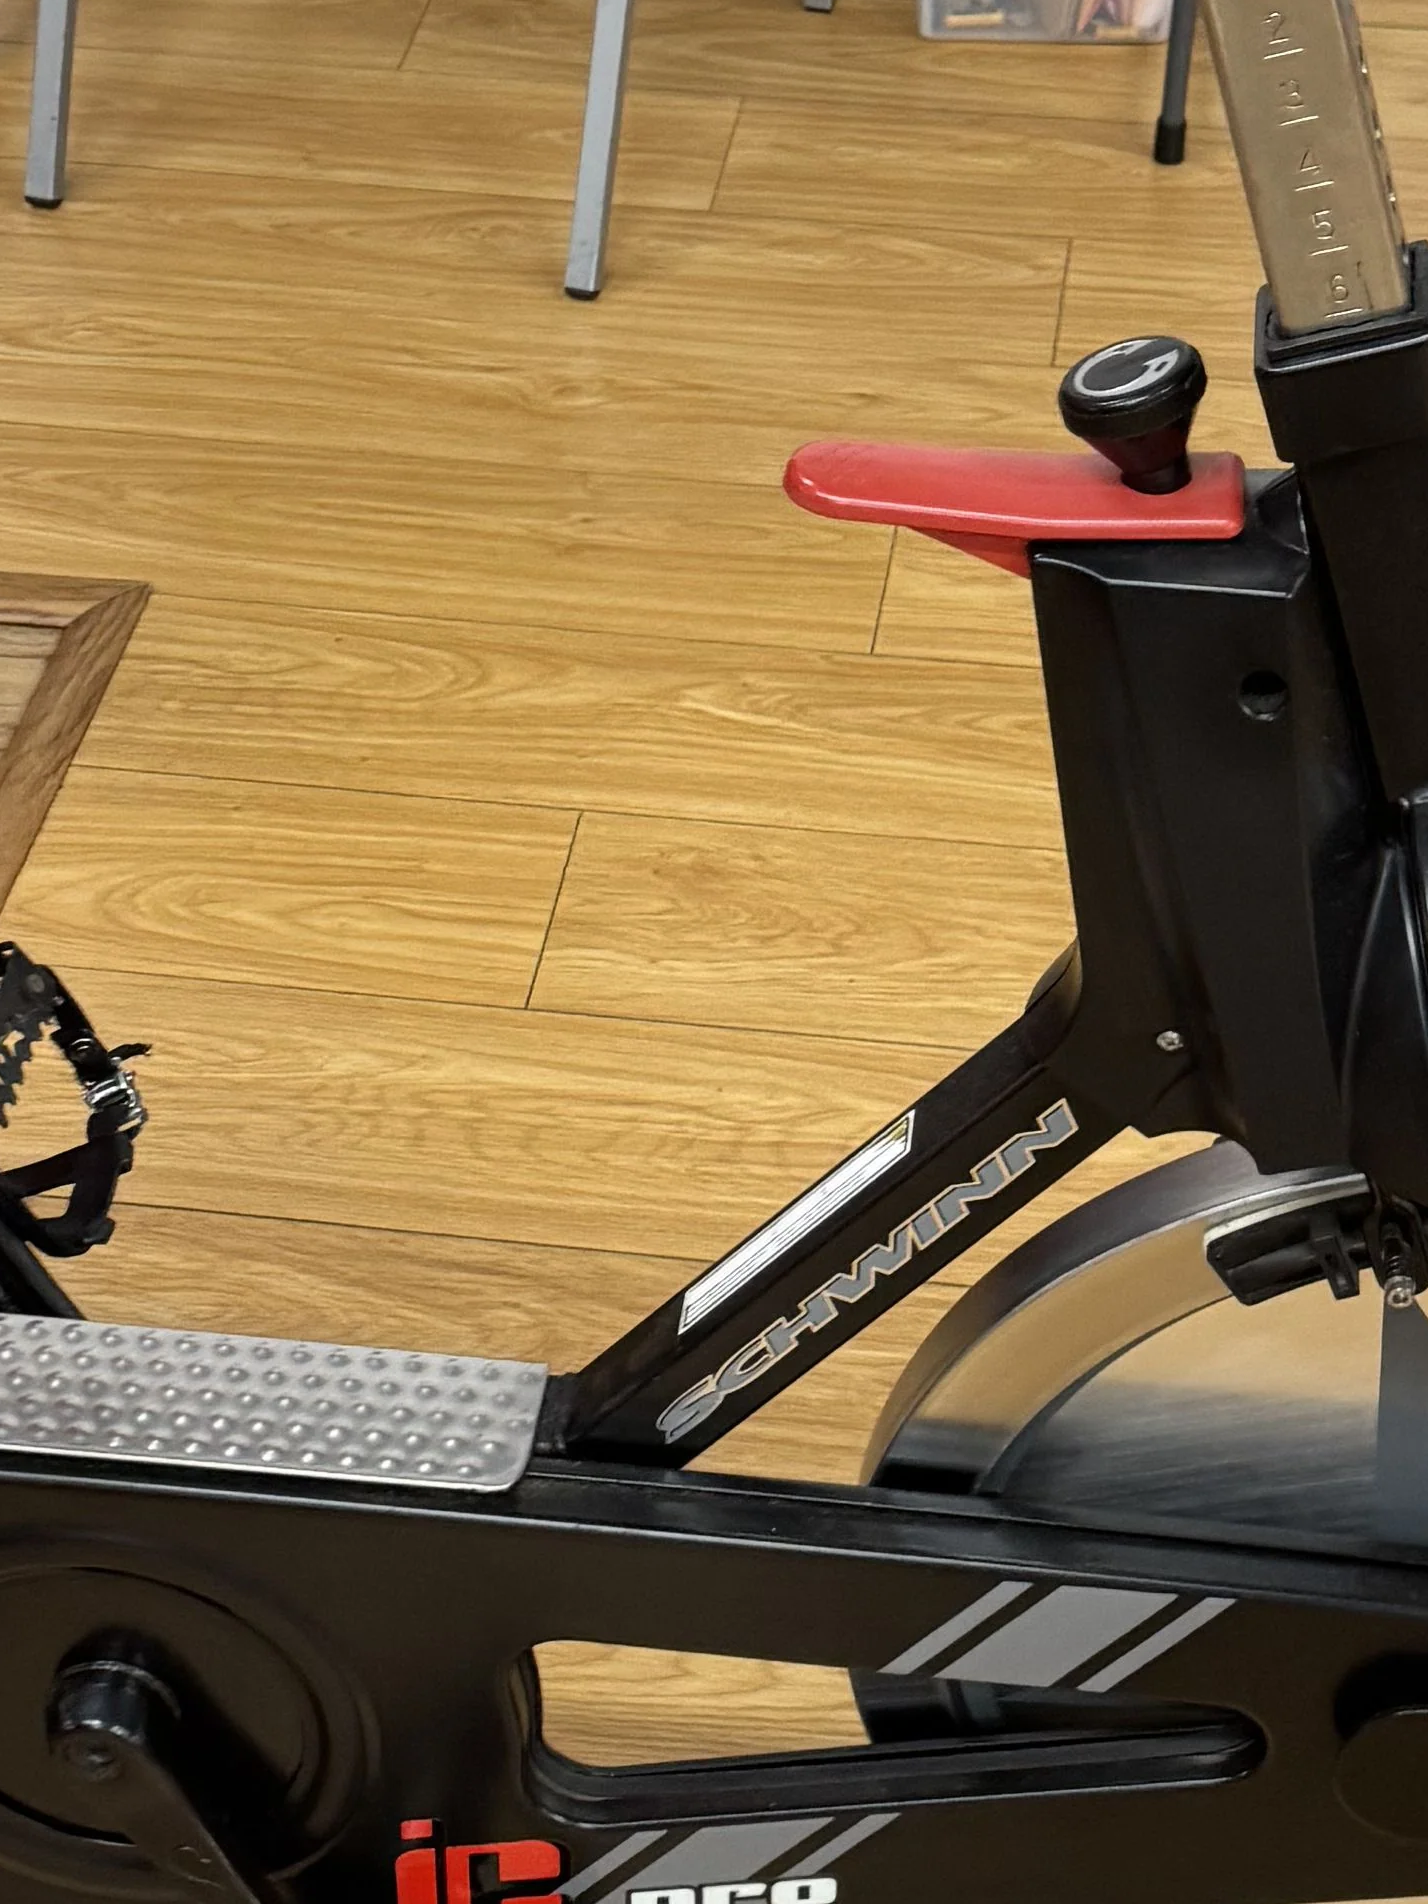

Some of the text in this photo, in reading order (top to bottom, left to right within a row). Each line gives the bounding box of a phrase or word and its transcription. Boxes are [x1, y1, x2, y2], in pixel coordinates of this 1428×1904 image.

[1311, 209, 1336, 241] 5
[1329, 273, 1350, 303] 6
[655, 1097, 1079, 1445] SCHWINN
